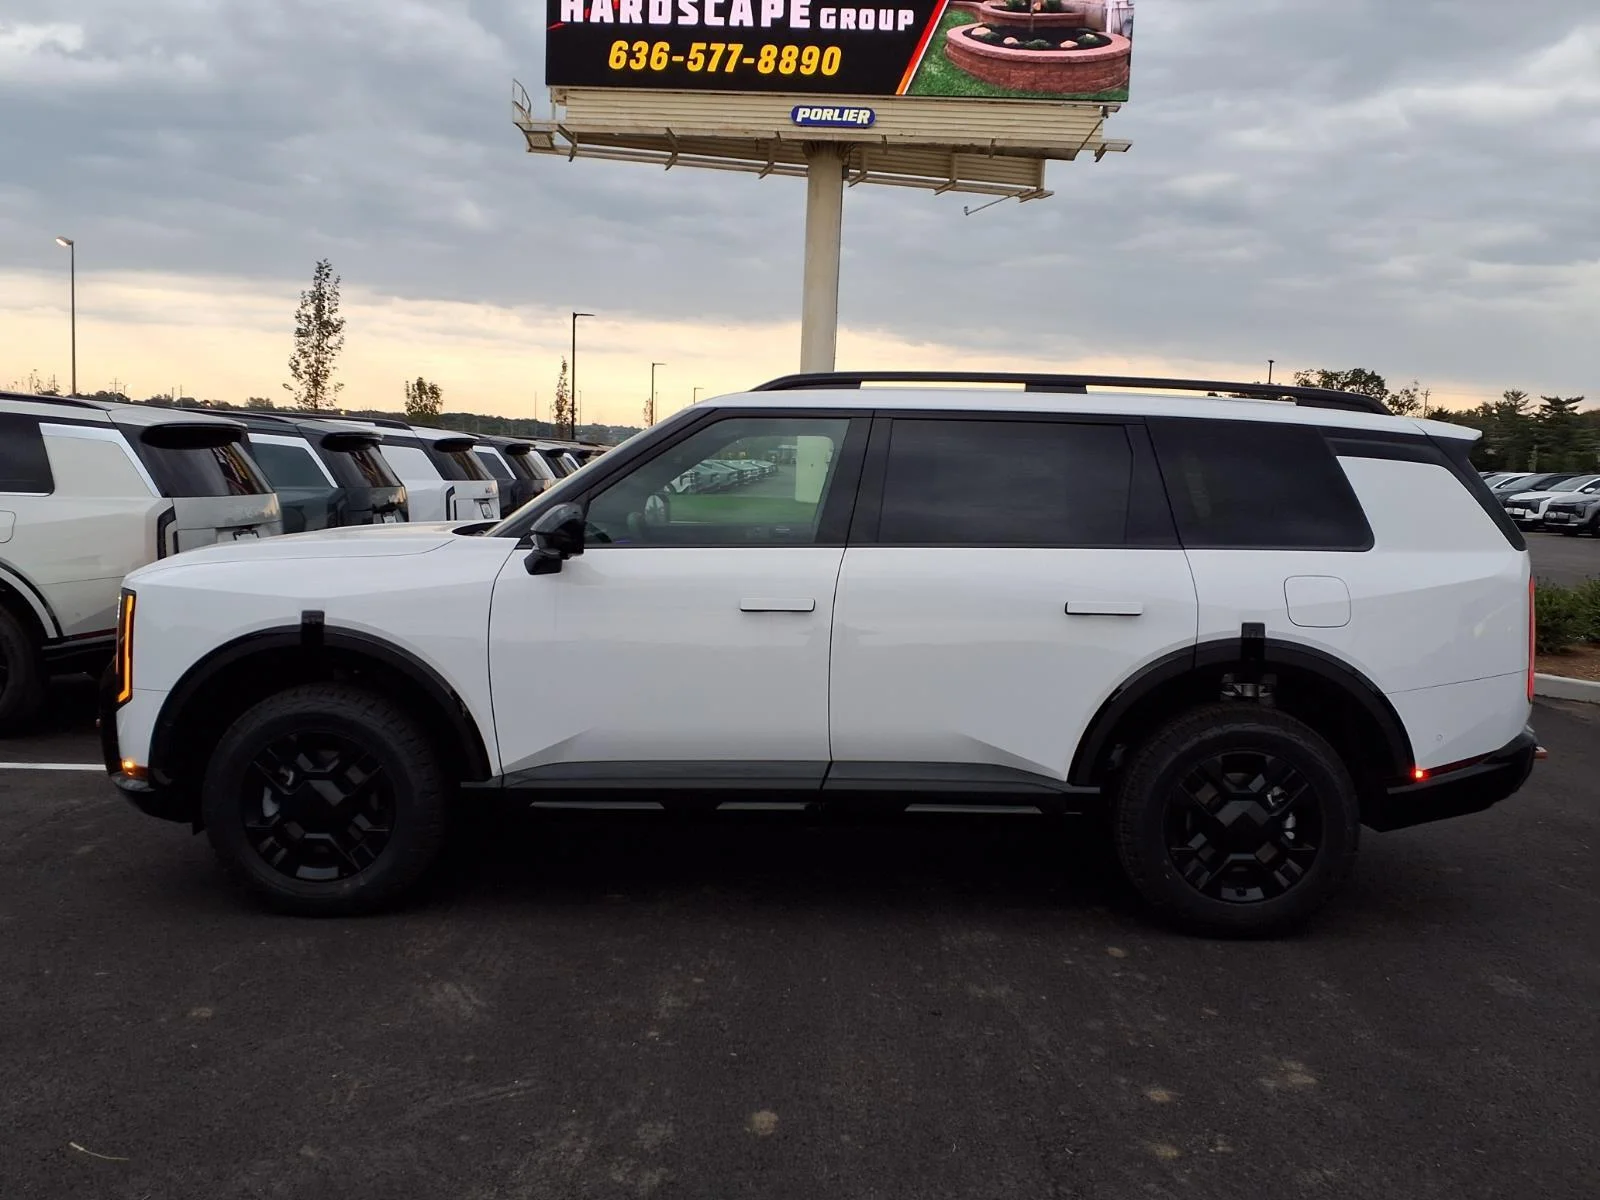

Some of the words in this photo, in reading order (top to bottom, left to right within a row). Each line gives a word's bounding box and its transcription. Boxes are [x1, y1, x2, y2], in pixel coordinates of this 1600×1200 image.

[560, 0, 812, 29] HARDSCAPE
[819, 7, 914, 31] GROUP
[608, 40, 842, 76] 636-577-8890
[796, 107, 871, 124] PORLIER
